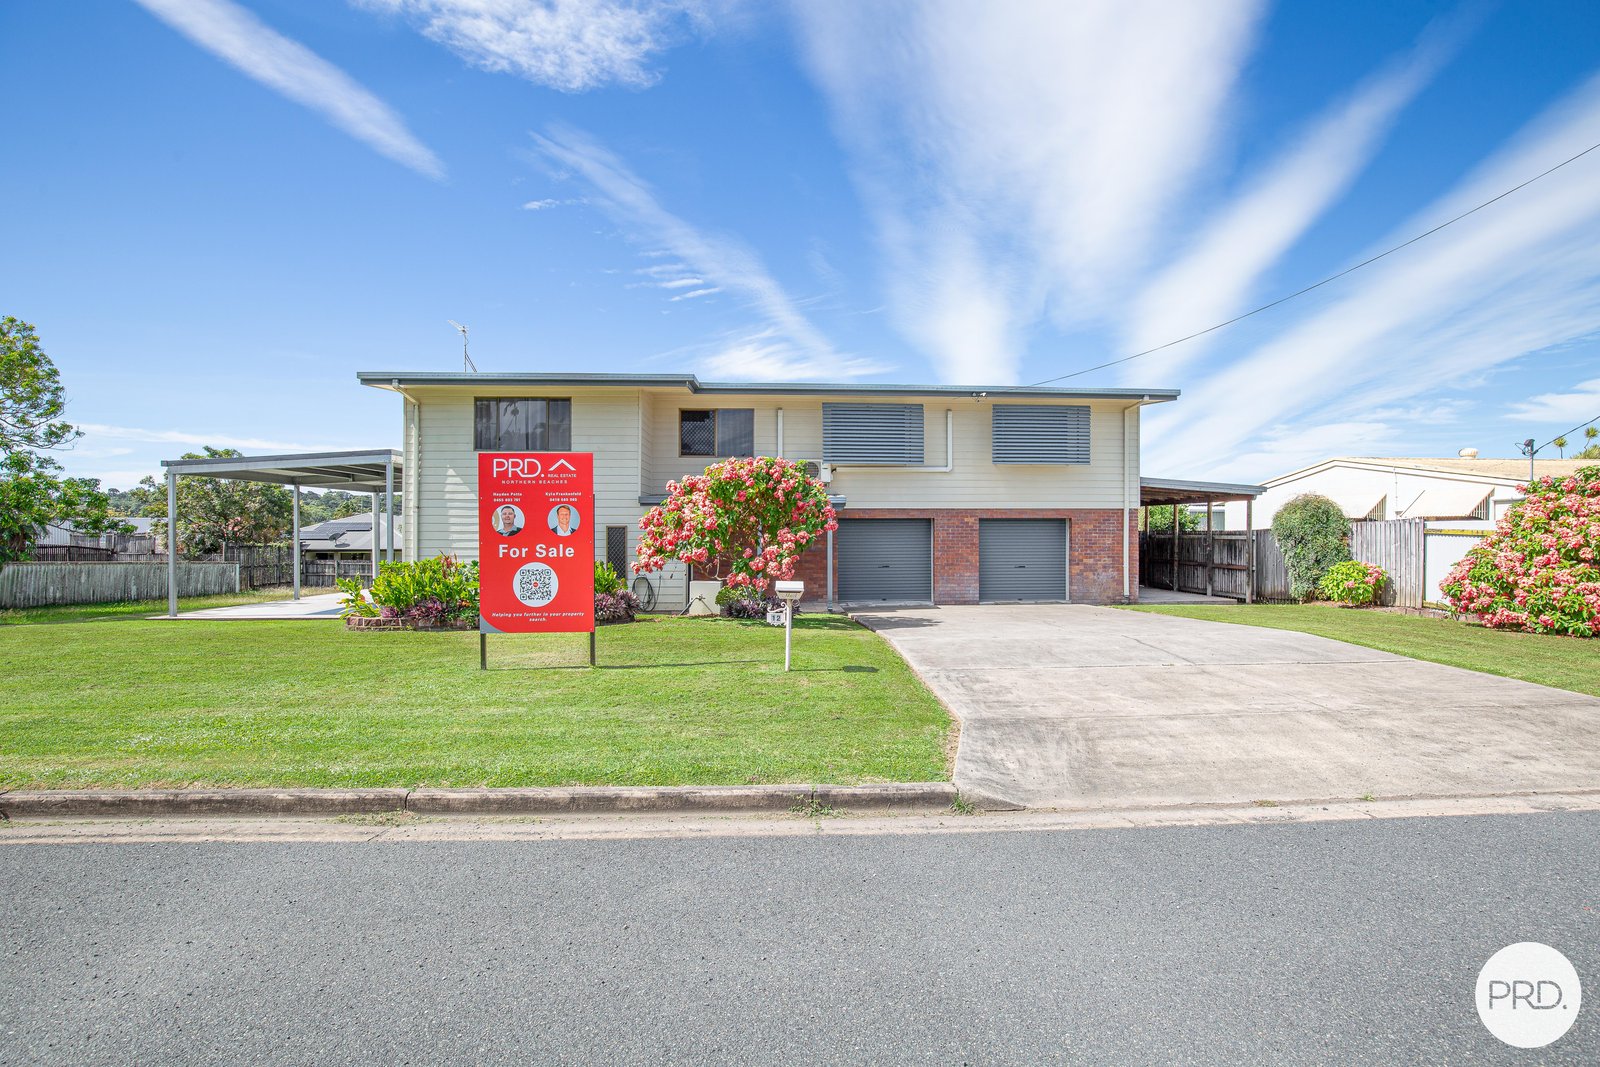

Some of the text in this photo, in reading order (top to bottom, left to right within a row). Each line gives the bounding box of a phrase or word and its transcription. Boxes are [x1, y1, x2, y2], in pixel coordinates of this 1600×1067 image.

[493, 458, 544, 478] PRD.
[498, 544, 574, 558] For Sale
